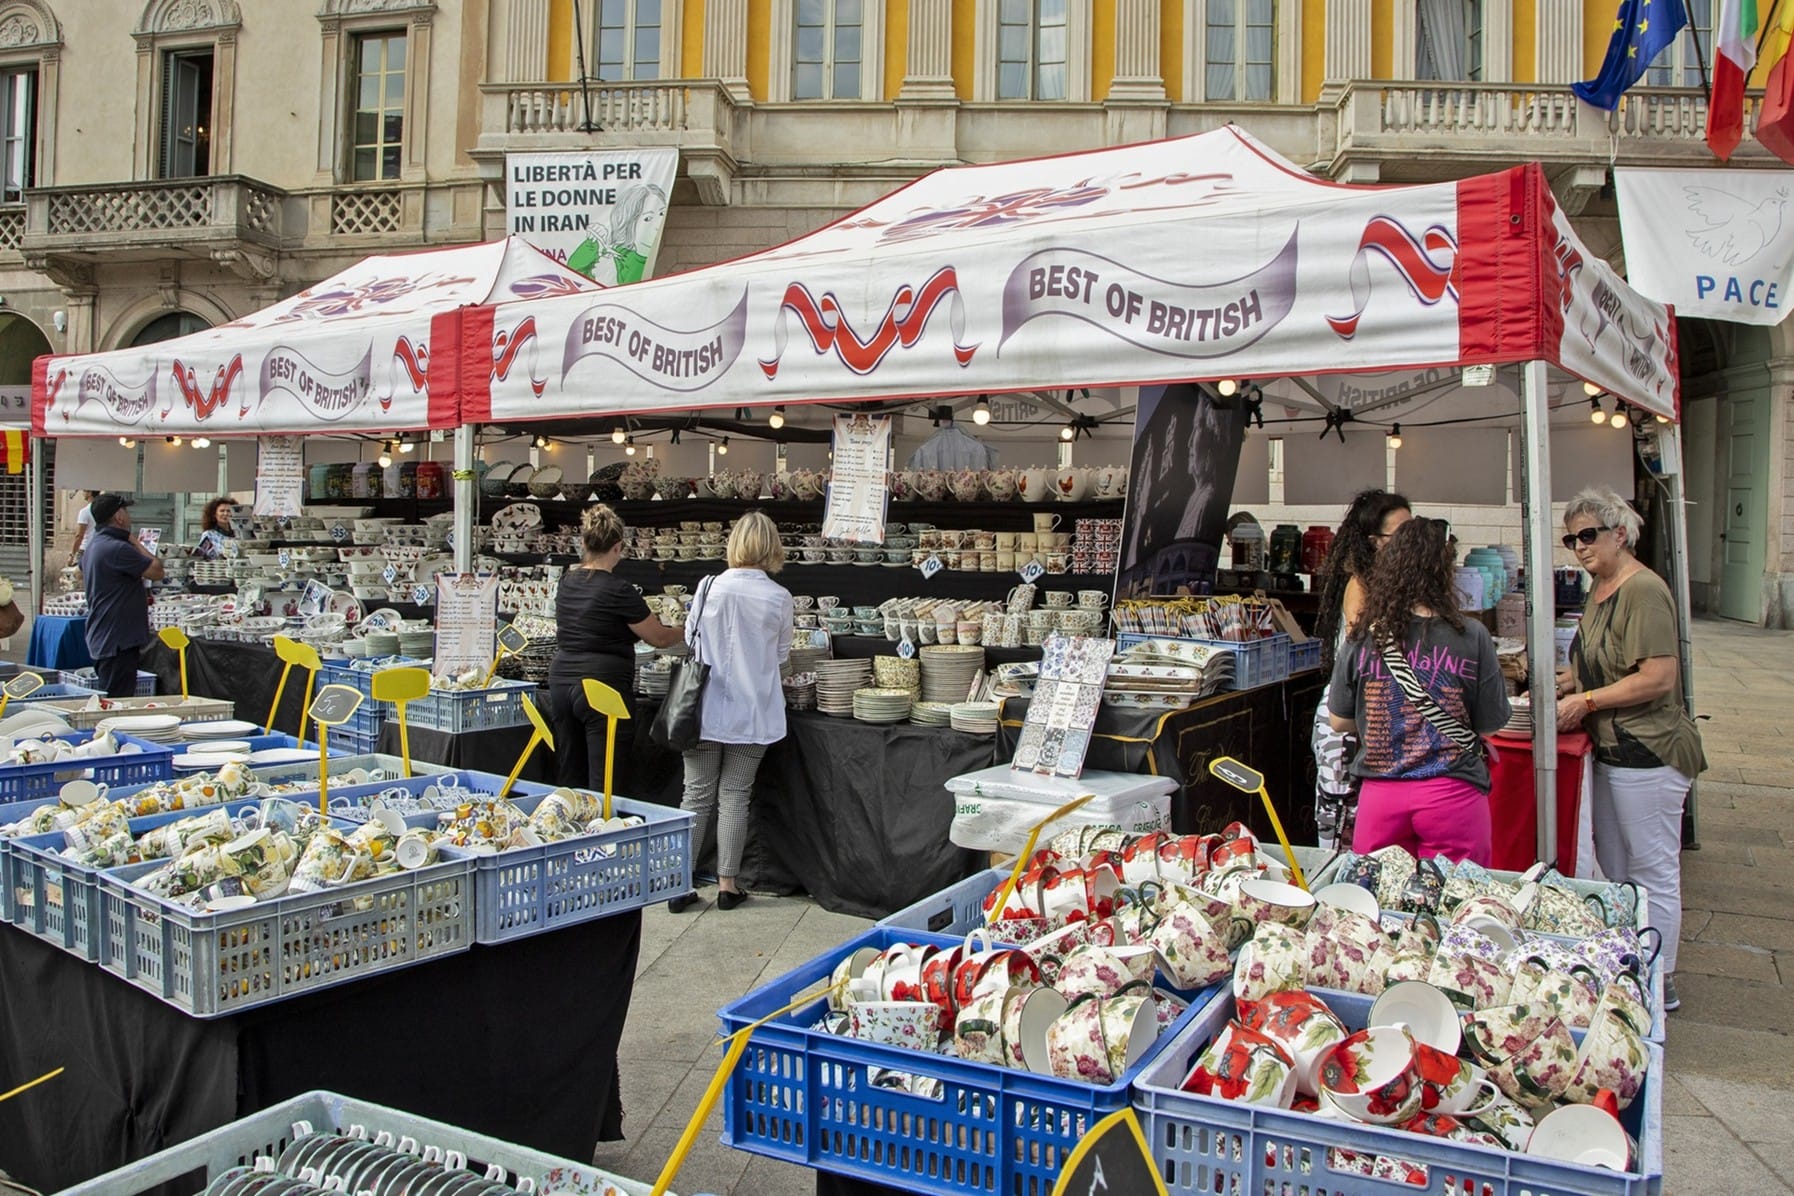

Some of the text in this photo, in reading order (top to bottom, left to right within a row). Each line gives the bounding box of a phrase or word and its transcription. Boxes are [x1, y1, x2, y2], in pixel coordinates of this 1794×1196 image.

[514, 161, 642, 183] LIBERTÀ PER
[514, 188, 617, 208] LE DONNE
[515, 214, 590, 233] IN IRAN
[1029, 265, 1263, 342] BEST OF BRITISH
[1696, 275, 1779, 308] PACE
[582, 316, 723, 378] BEST OF BRITISH
[86, 373, 149, 417] BEST OF BRITISH
[270, 356, 357, 411] BEST OF BRITISH
